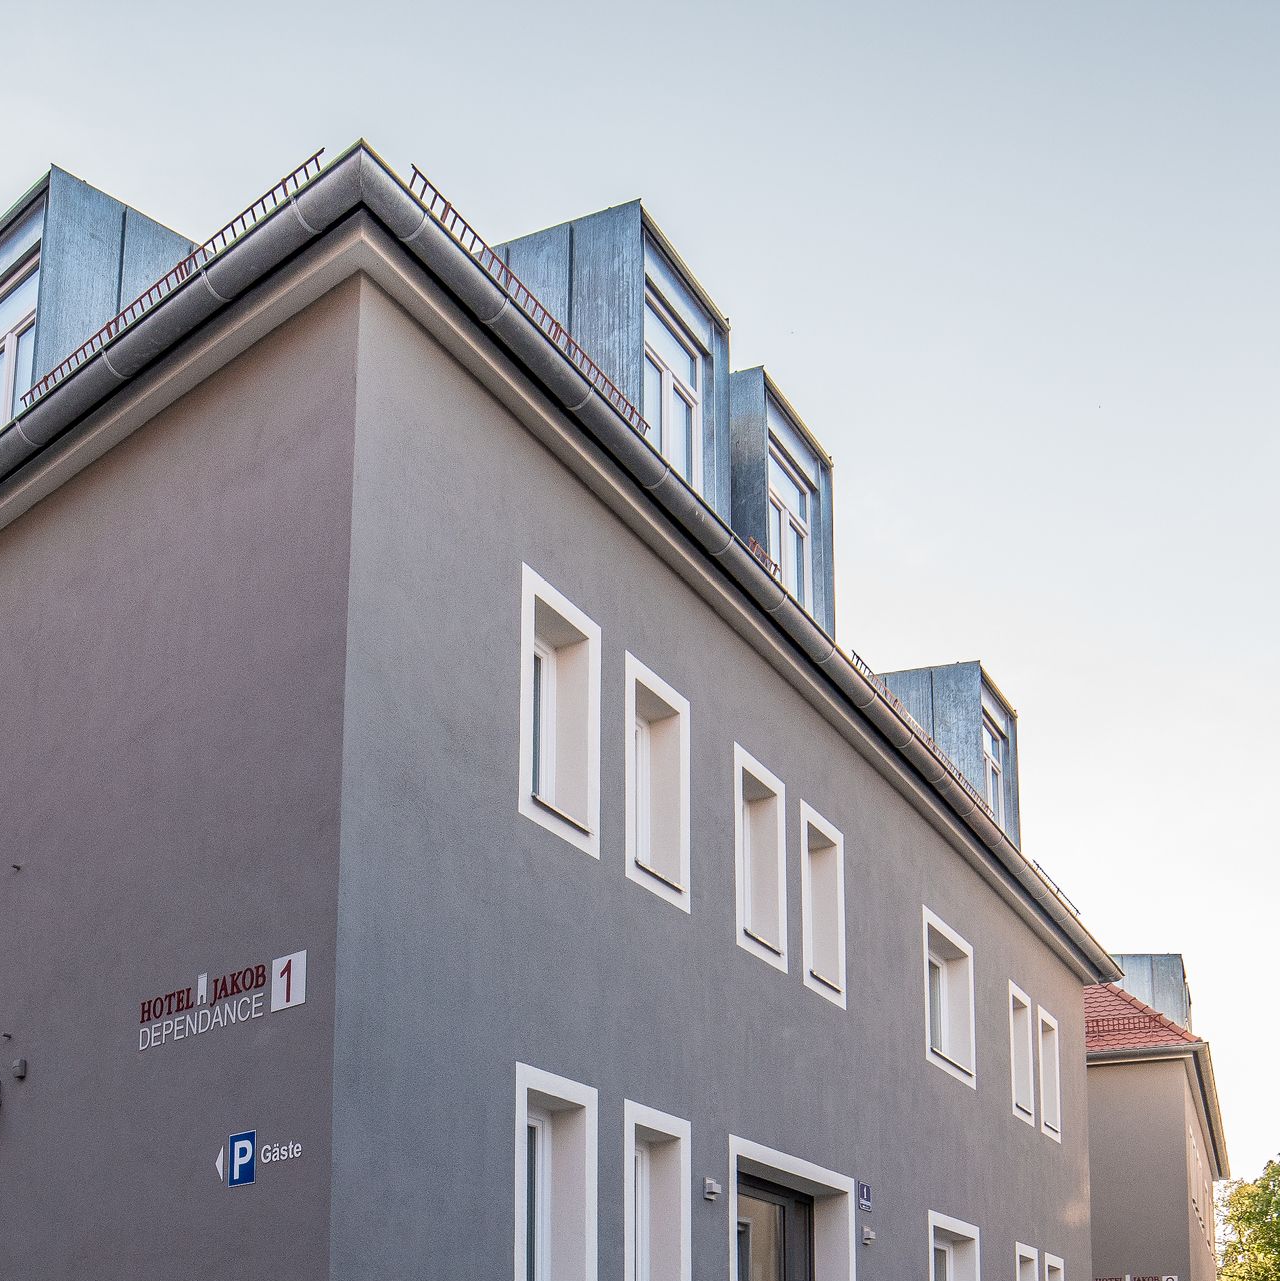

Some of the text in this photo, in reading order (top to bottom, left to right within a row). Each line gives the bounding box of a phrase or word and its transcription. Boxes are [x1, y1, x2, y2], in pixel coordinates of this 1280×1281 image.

[140, 964, 267, 1024] HOTEL JAKOB
[279, 958, 293, 1003] 1
[138, 992, 265, 1051] DEPENDANCE
[233, 1139, 302, 1180] P Gäste
